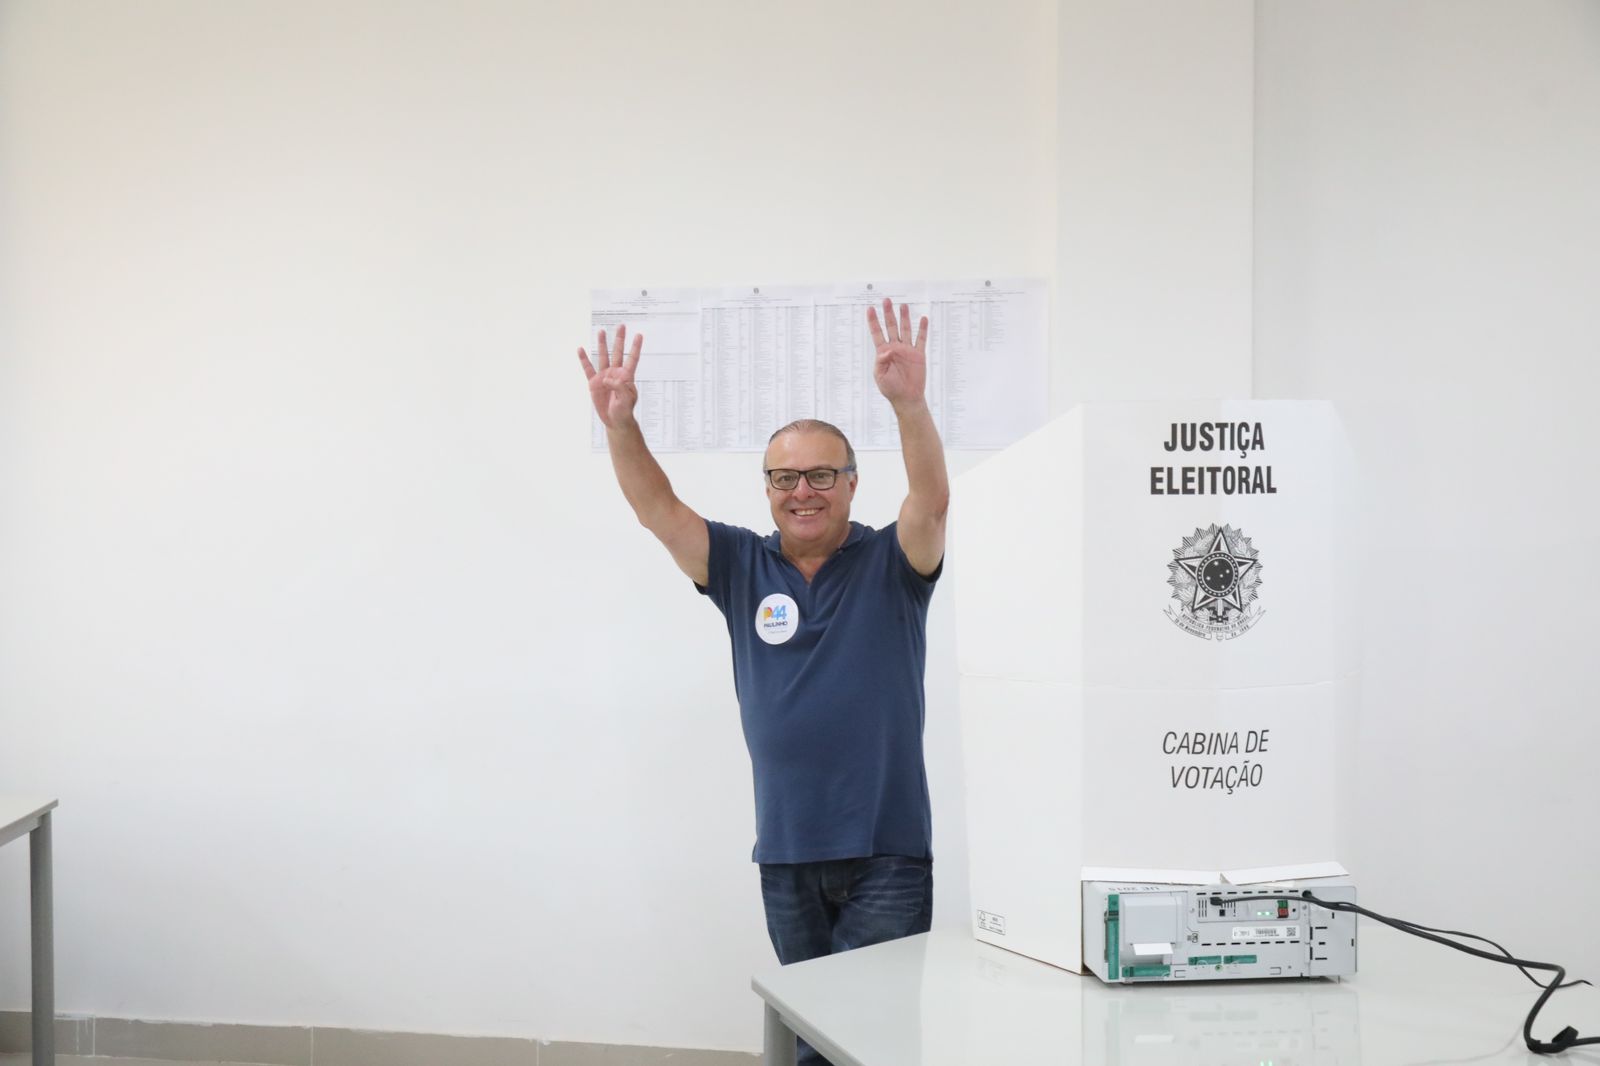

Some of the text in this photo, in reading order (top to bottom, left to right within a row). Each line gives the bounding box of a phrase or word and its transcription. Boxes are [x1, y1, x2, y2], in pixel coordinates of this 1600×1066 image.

[1163, 421, 1265, 459] JUSTIÇA
[1150, 465, 1277, 495] ELEITORAL
[1162, 729, 1270, 755] CABINA DE
[1171, 760, 1263, 795] VOTAÇÃO
